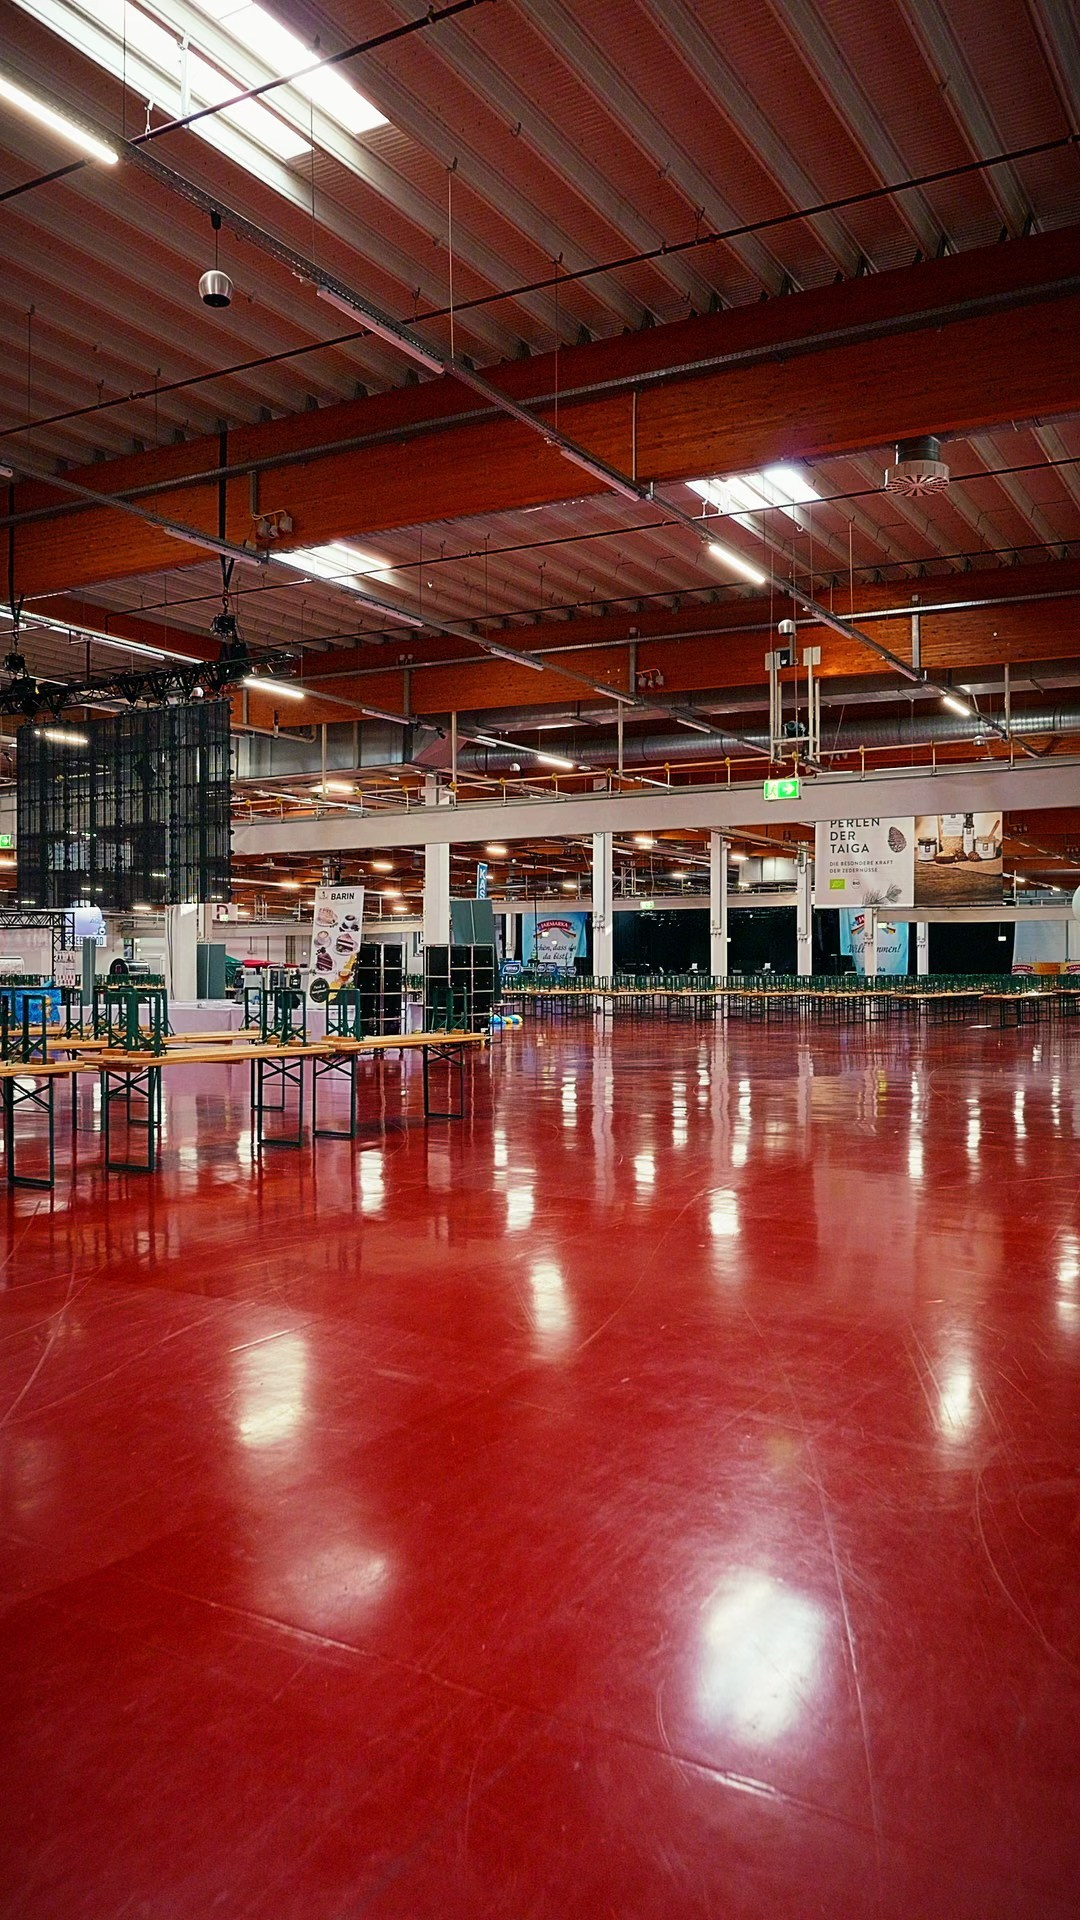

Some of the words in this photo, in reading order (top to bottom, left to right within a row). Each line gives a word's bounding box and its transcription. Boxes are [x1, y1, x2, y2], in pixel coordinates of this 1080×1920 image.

[830, 818, 880, 828] PERLEN
[830, 831, 856, 841] DER
[830, 843, 870, 854] TAIGA
[330, 892, 355, 900] BARIN
[847, 943, 902, 953] Willmmen!
